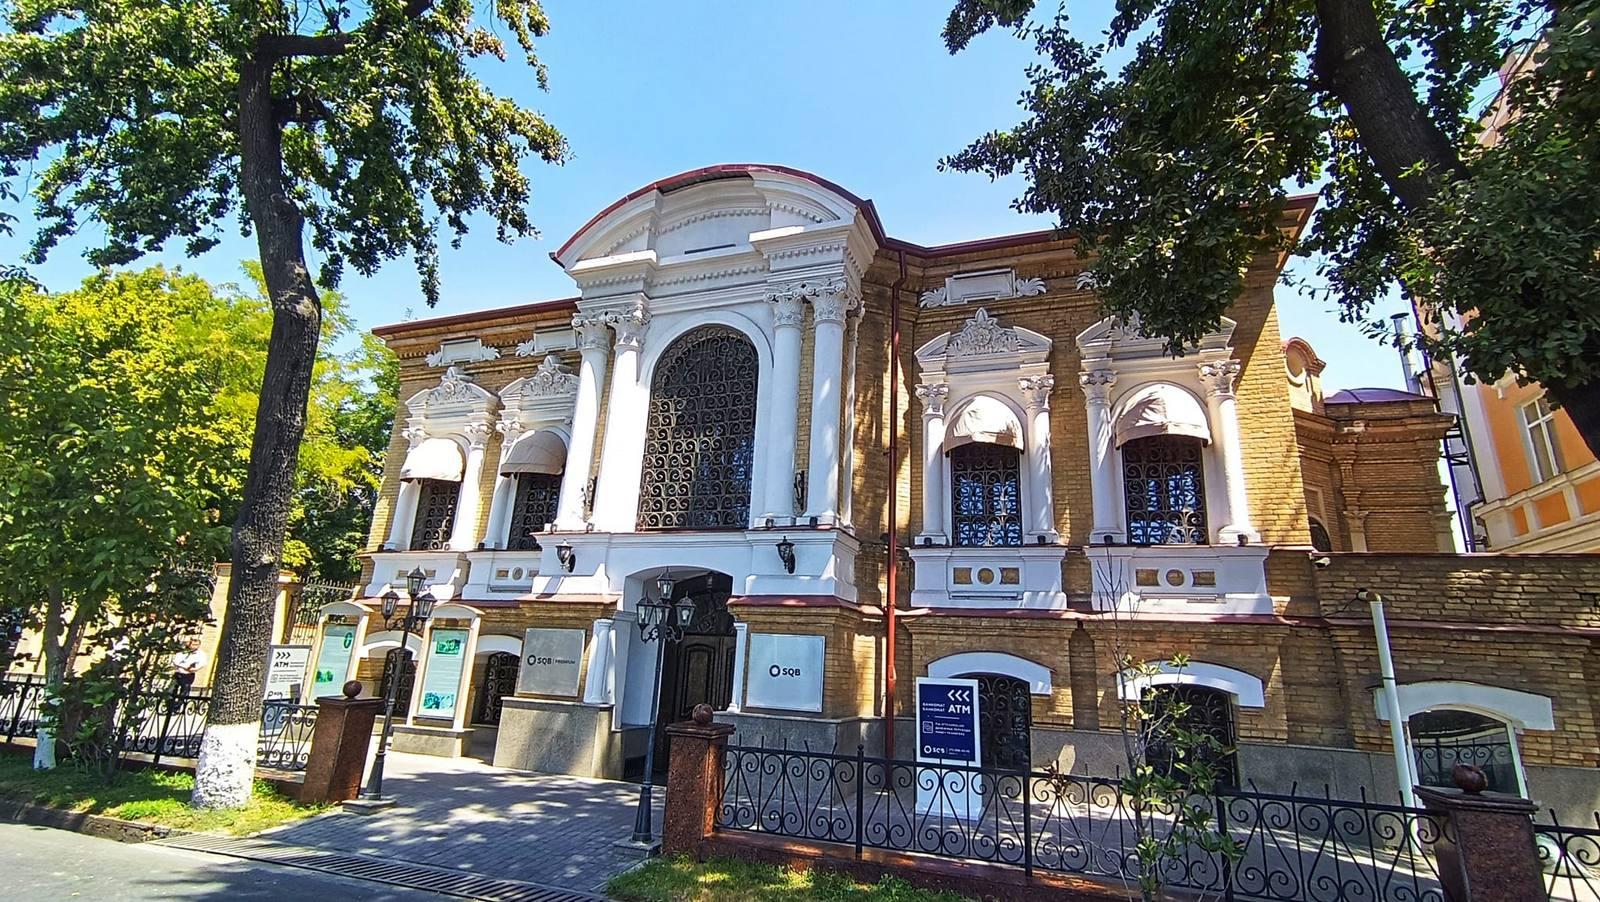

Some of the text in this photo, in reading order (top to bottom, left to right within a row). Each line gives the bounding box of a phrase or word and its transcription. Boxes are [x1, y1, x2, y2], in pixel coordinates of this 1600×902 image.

[537, 657, 552, 666] SQB
[782, 667, 801, 678] SQB
[948, 704, 971, 715] ATM
